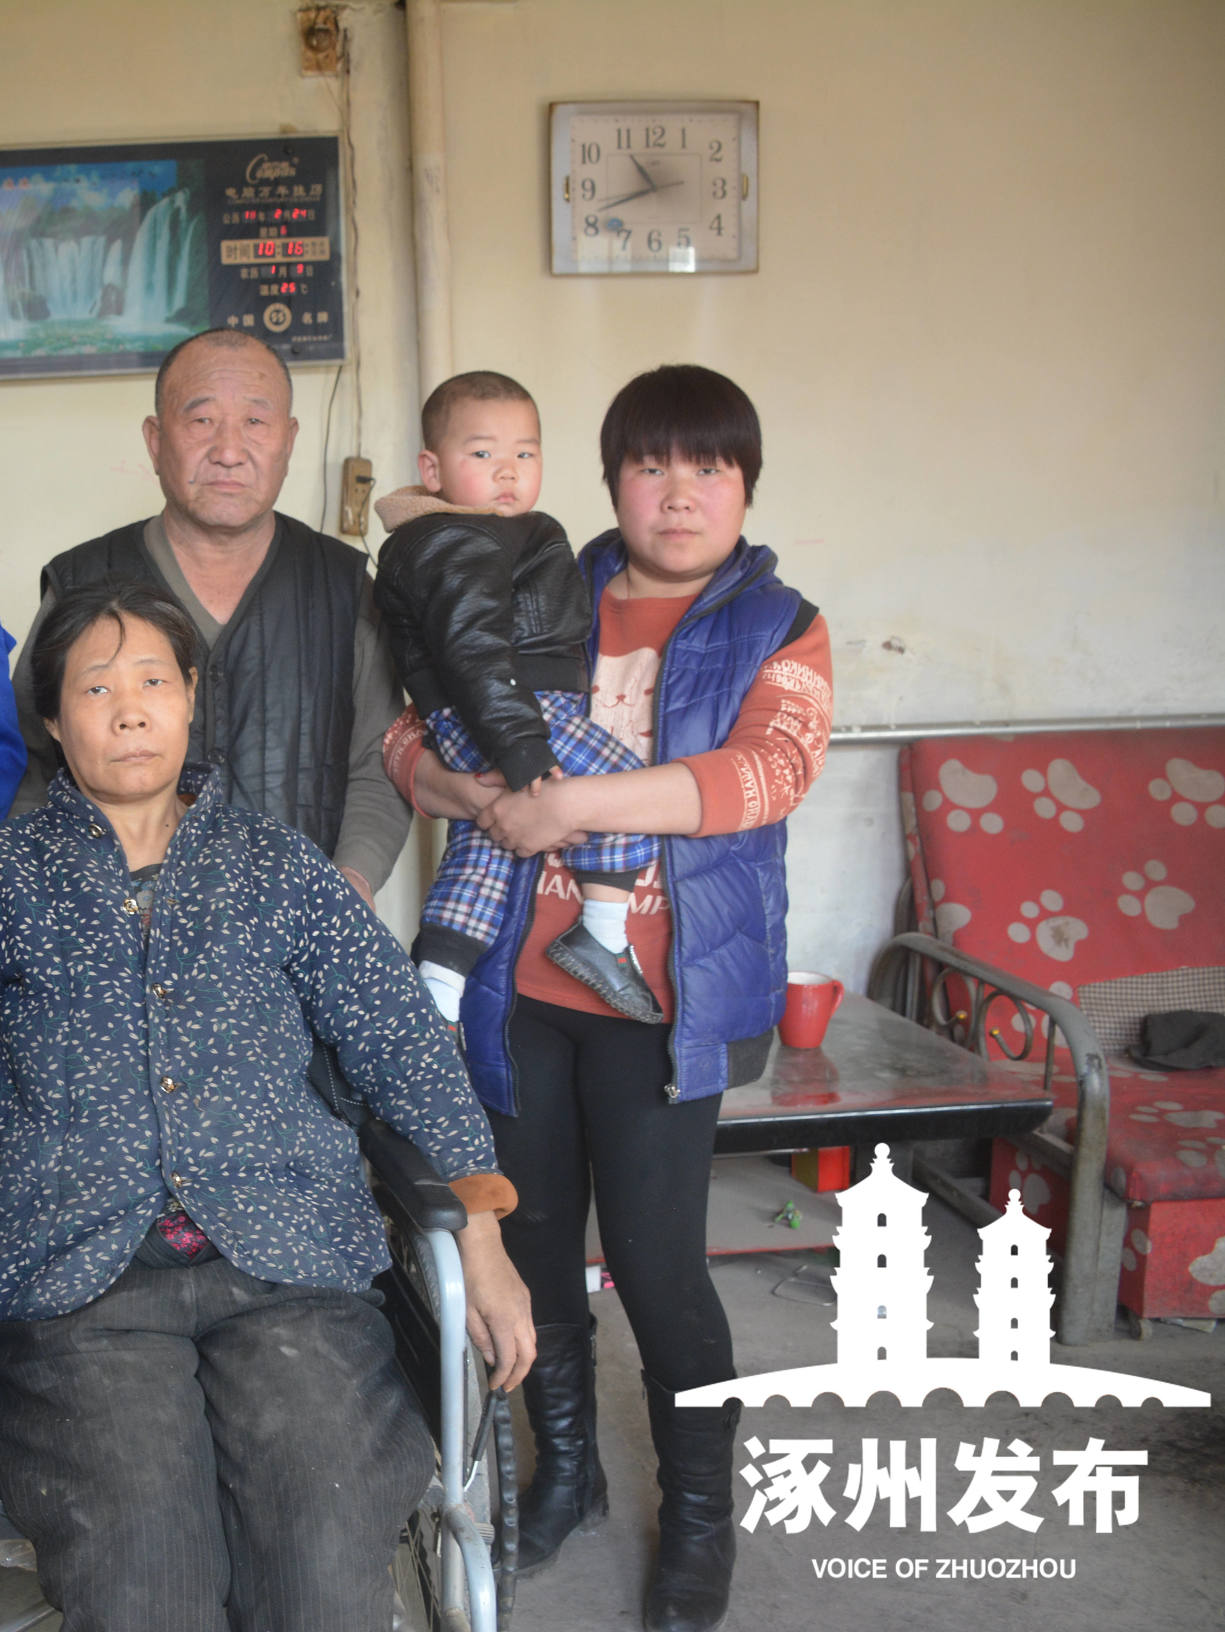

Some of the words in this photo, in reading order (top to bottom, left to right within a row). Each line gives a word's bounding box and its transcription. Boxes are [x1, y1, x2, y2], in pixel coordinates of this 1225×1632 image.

[616, 127, 631, 149] 11
[644, 126, 666, 148] 12
[680, 127, 687, 149] 1
[581, 142, 601, 165] 10
[708, 140, 723, 162] 2
[581, 178, 596, 200] 9
[712, 177, 726, 200] 3
[584, 215, 599, 237] 8
[709, 214, 723, 236] 4
[616, 228, 631, 251] 7
[647, 229, 662, 252] 6
[677, 228, 691, 249] 5
